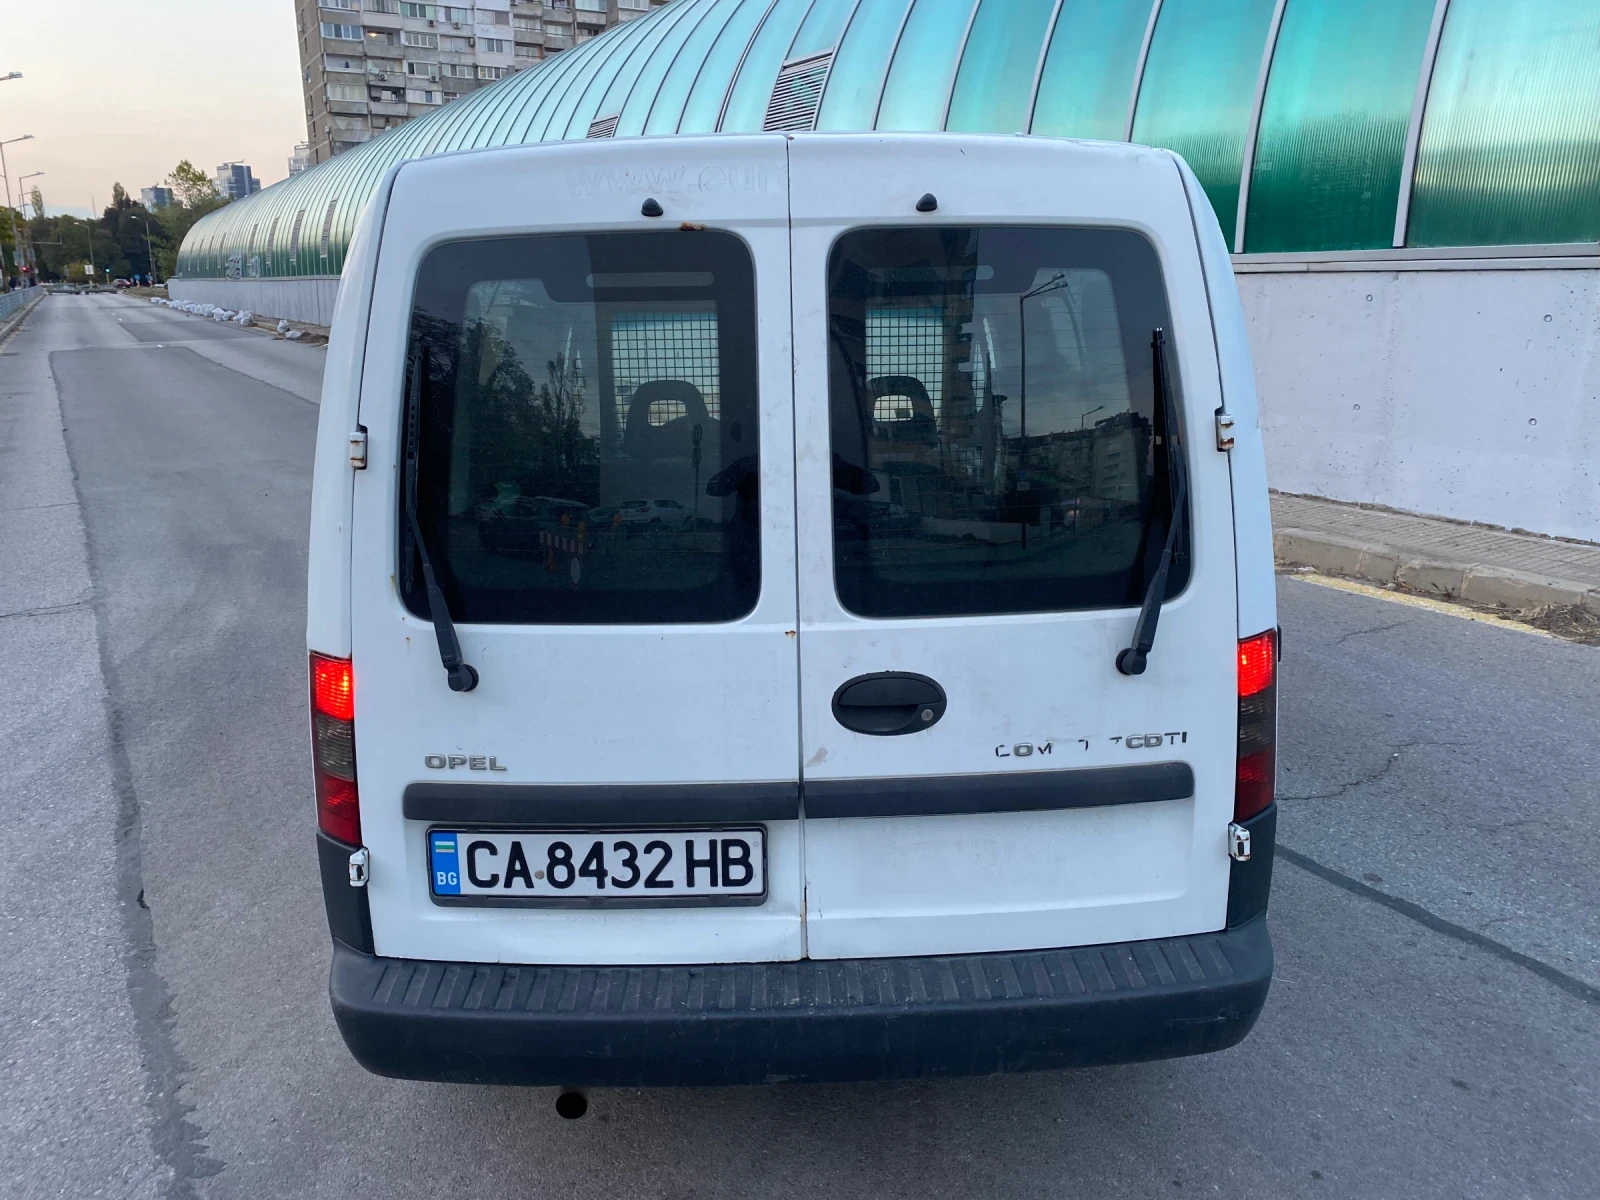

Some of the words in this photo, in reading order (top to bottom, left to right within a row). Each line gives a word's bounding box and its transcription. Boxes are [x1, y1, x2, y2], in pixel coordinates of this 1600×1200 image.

[425, 754, 507, 771] OPEL
[466, 841, 534, 889] CA
[546, 841, 674, 889] 8432
[685, 839, 754, 888] HB
[437, 871, 457, 885] BG
